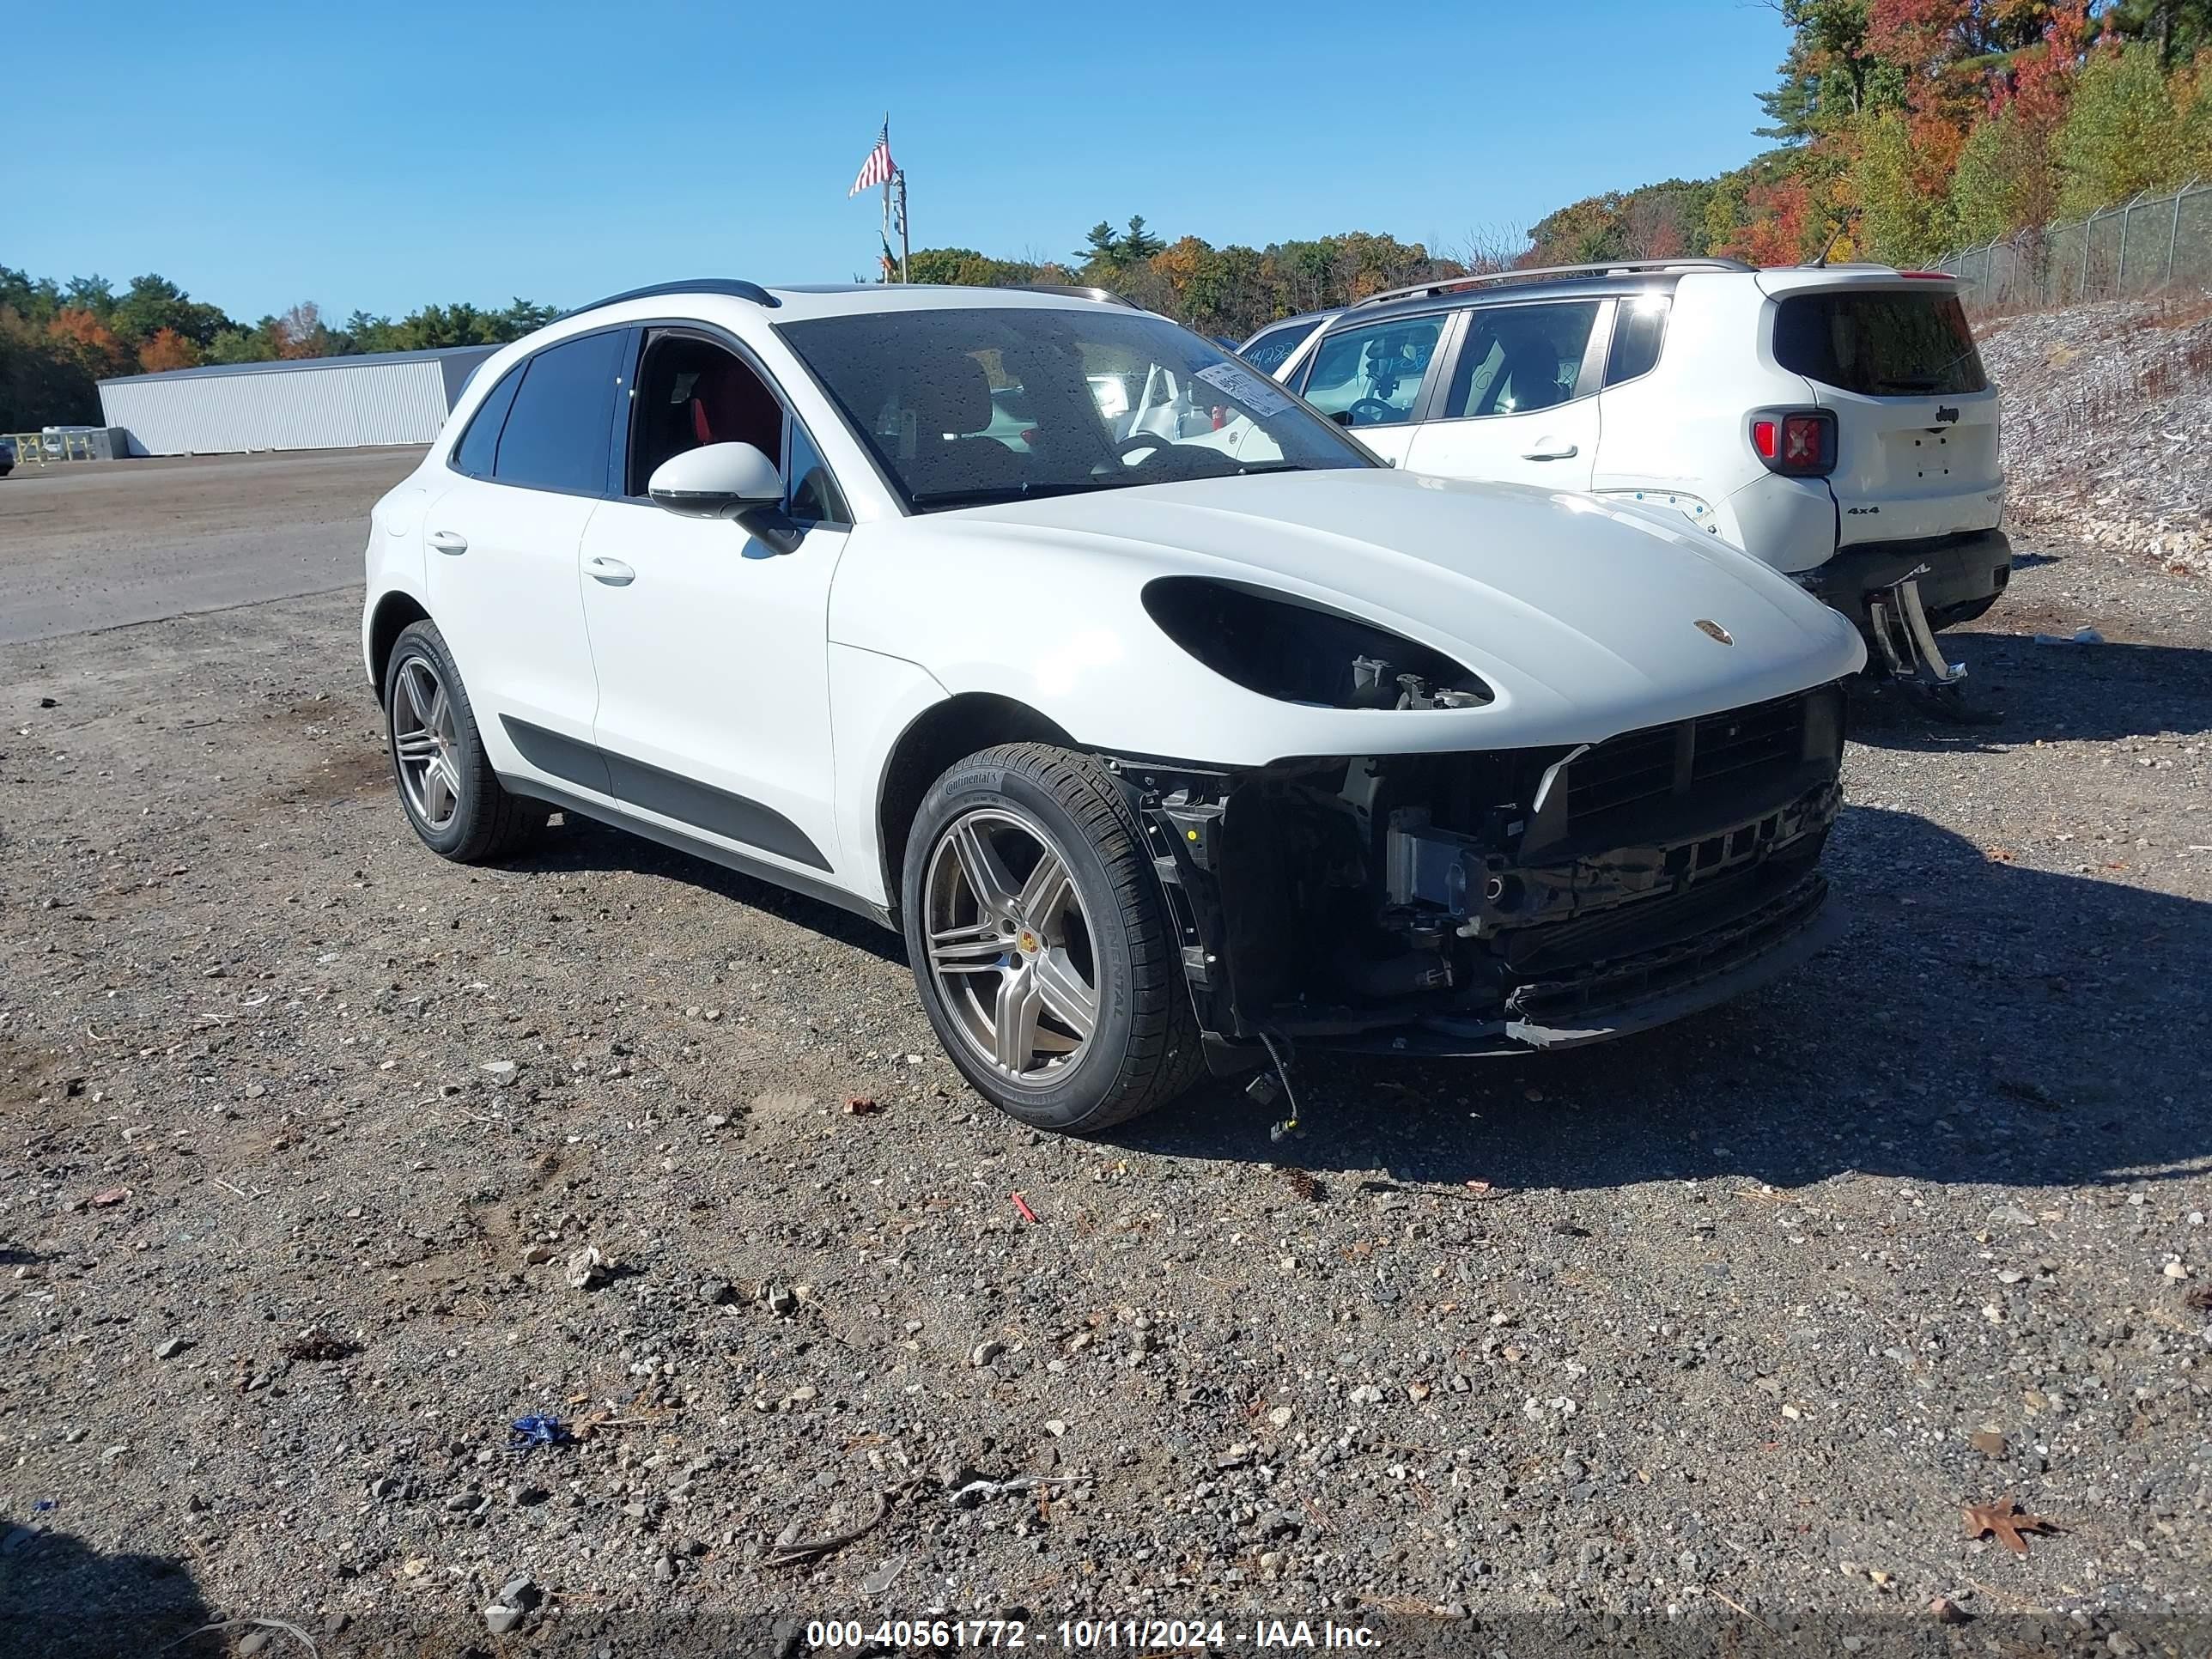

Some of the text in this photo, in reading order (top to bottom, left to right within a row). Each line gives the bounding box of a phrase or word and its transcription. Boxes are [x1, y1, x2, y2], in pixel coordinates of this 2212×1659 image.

[1936, 404, 1960, 423] Jeep
[1847, 506, 1881, 515] 4x4
[945, 771, 990, 795] Continental
